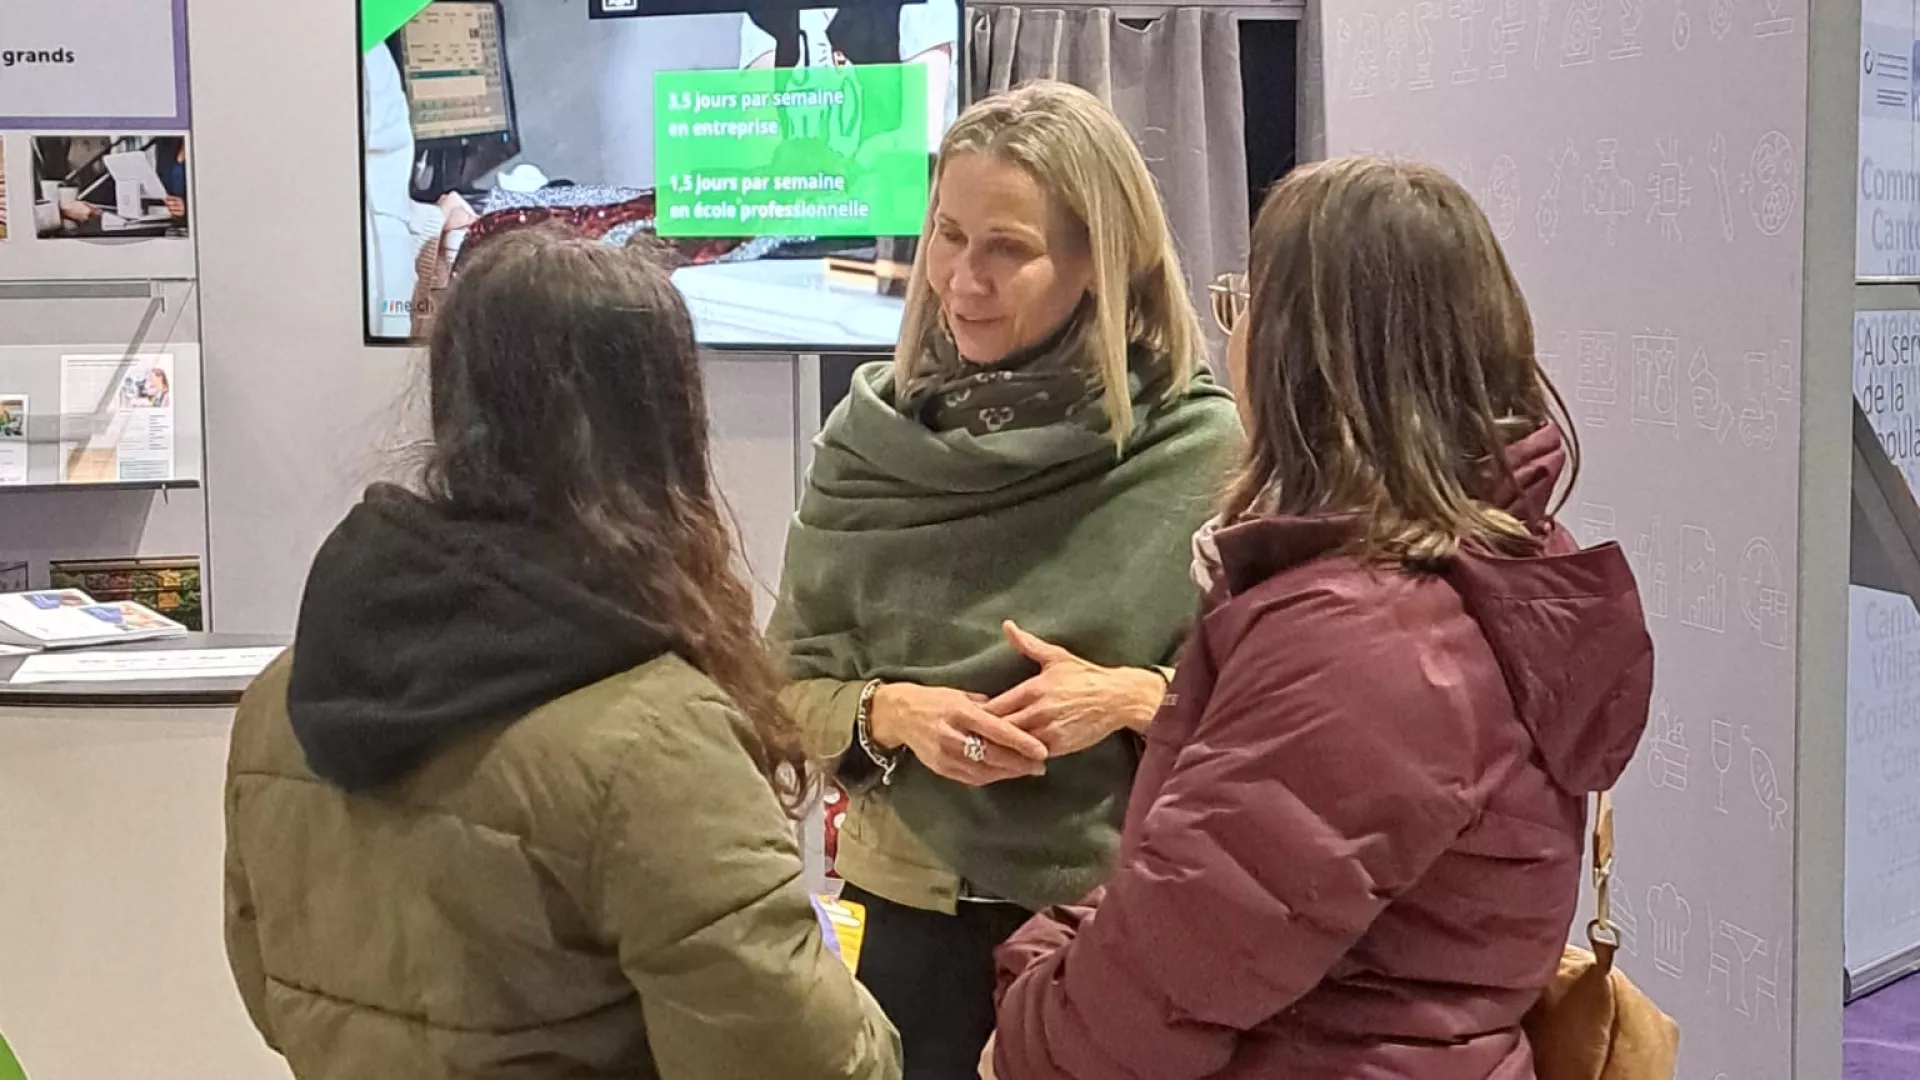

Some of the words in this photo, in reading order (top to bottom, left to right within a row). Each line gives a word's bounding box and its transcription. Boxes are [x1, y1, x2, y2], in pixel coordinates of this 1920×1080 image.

[2, 47, 76, 67] grands
[694, 90, 737, 114] jours
[741, 91, 769, 113] par
[772, 87, 845, 107] semaine
[668, 122, 689, 137] en
[692, 118, 778, 140] entreprise
[669, 173, 692, 193] 1,5
[695, 172, 738, 195] jours
[742, 174, 770, 196] par
[773, 171, 845, 192] semaine
[669, 204, 690, 219] en
[693, 200, 737, 219] école
[740, 198, 869, 223] professionnelle
[1862, 327, 1886, 367] Au
[1863, 373, 1885, 414] de
[1889, 371, 1905, 413] la
